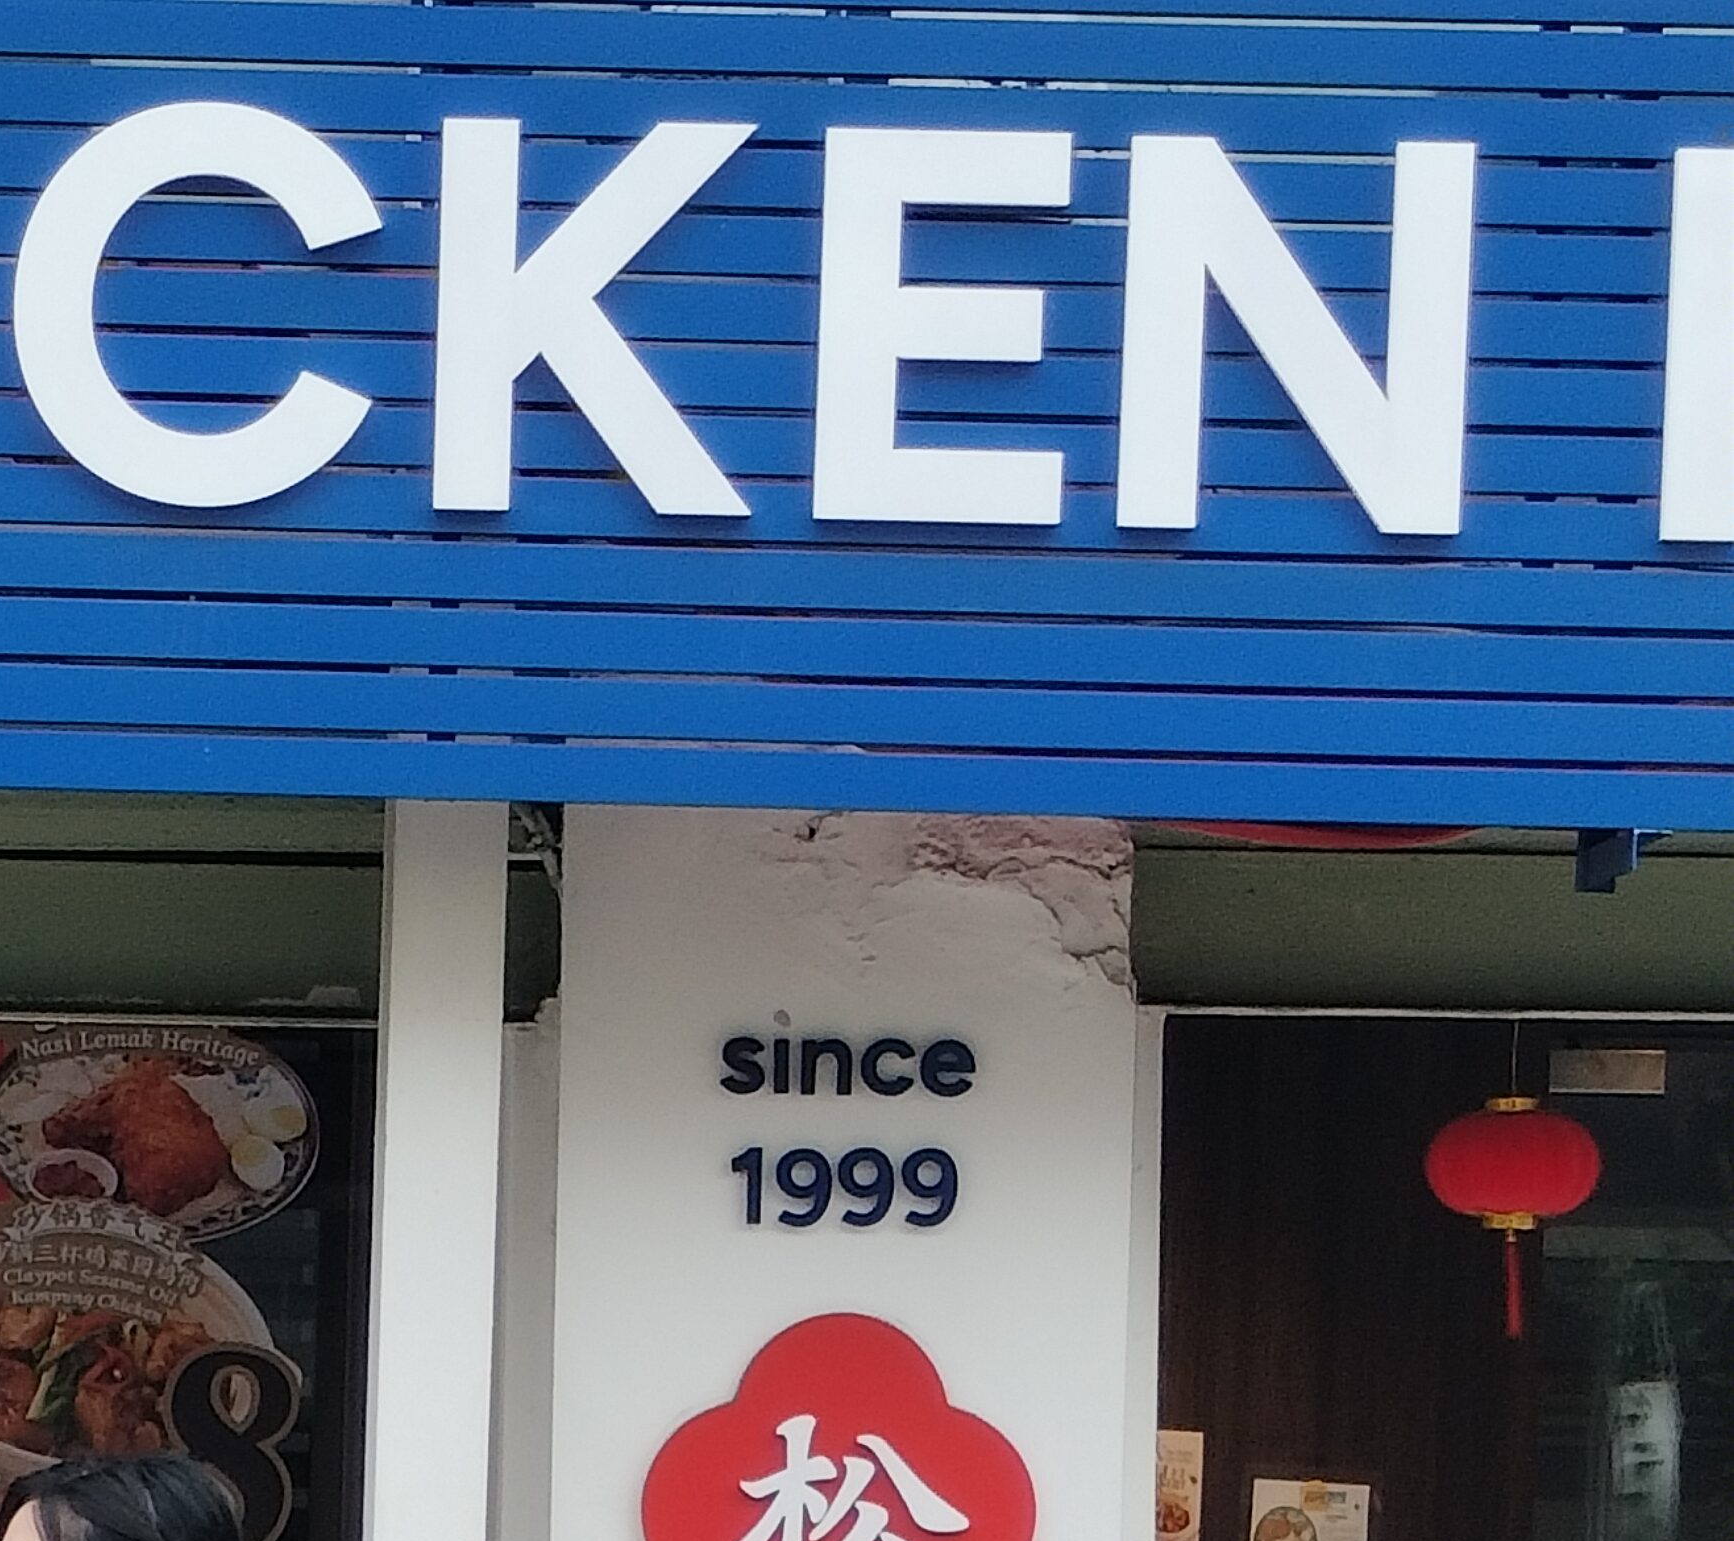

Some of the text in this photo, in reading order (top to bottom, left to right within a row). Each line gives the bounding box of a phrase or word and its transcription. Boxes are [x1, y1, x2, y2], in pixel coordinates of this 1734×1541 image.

[22, 1029, 260, 1066] Nasi Lemak Heritage
[719, 1034, 977, 1098] since
[731, 1146, 959, 1227] 1999
[4, 1269, 73, 1288] Claypot
[12, 1290, 94, 1309] Kampung
